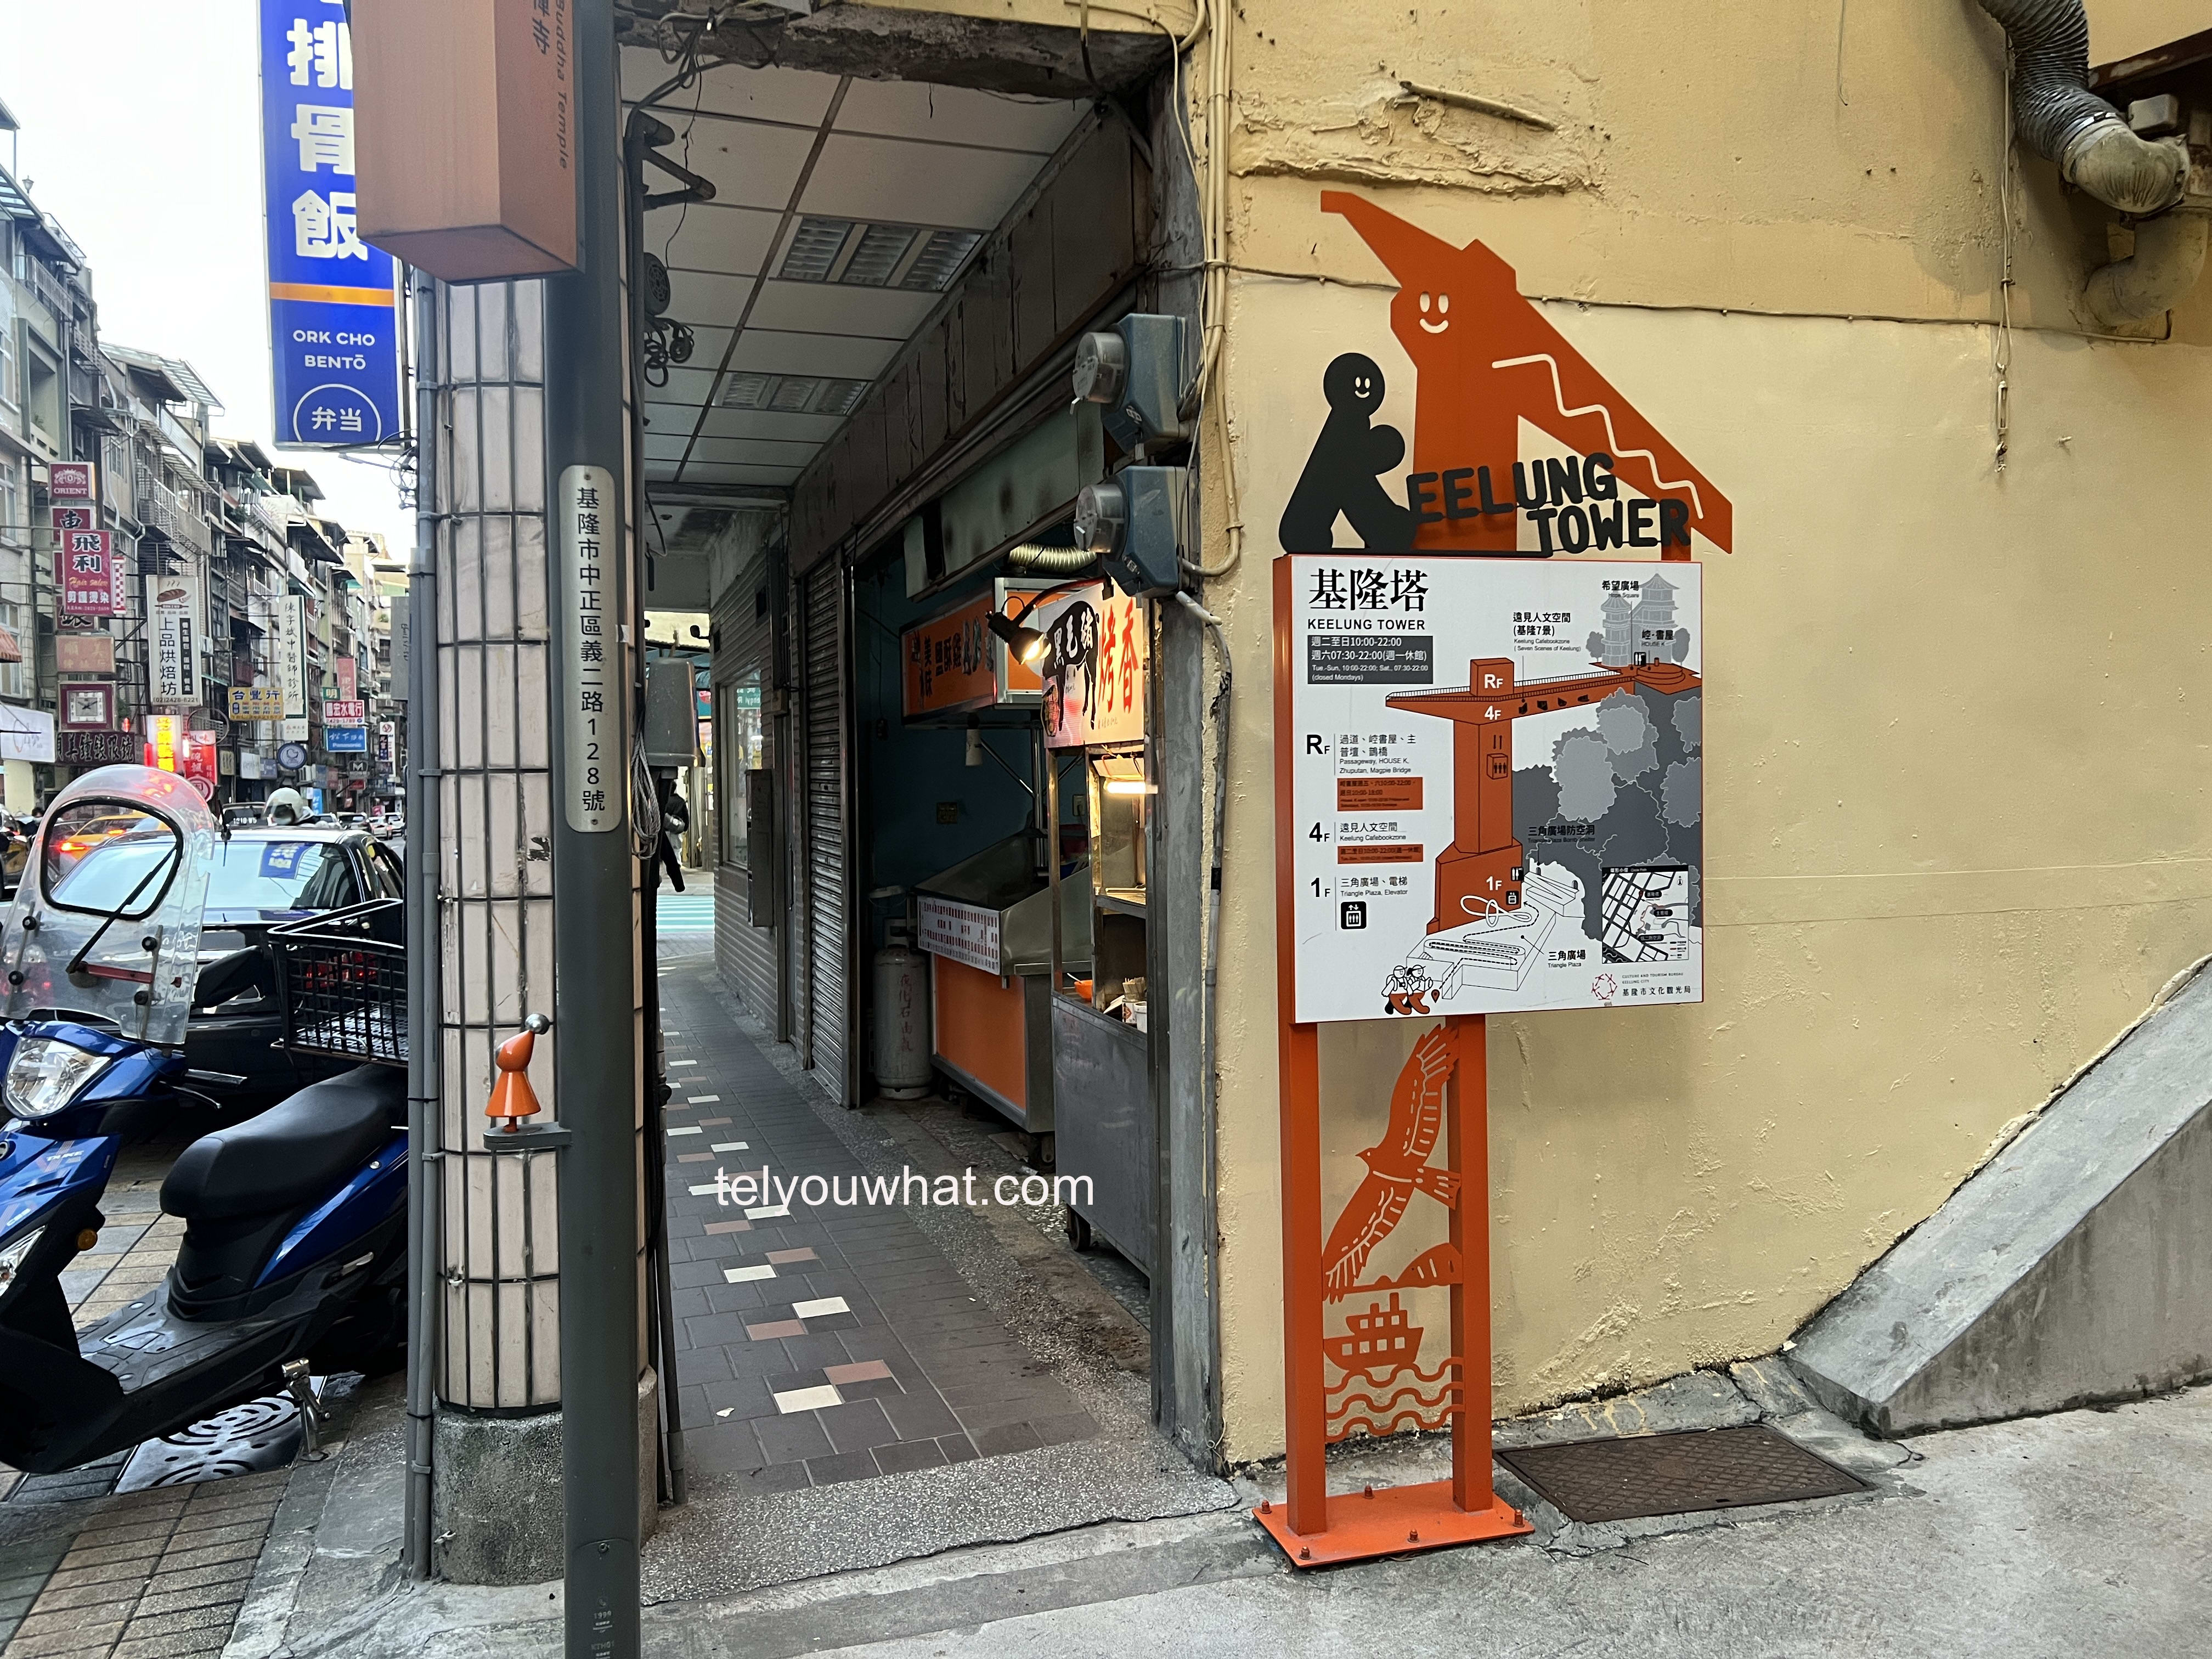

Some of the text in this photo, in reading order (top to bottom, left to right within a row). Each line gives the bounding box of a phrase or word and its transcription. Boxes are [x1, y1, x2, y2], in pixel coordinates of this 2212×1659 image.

[286, 0, 368, 261] 排骨飯
[557, 91, 569, 169] Temple
[293, 330, 375, 346] ORK CHO
[1527, 498, 1691, 557] TOWER
[72, 532, 102, 574] 飛利
[1308, 568, 1429, 612] 基隆塔
[1601, 580, 1640, 591] 希望廣場
[1308, 619, 1426, 630] KEELUNG TOWER
[1513, 612, 1571, 623] 遠見人文空間
[1513, 625, 1555, 637] (基隆7景)
[576, 487, 605, 811] 基隆市中正區義二路128號
[1311, 636, 1402, 647] 週二至日10:00-22:00
[159, 617, 177, 696] 上品烘焙坊
[1311, 650, 1426, 662] 週六07:30-22:00(週一休館)
[1484, 674, 1503, 689] RF
[326, 689, 338, 698] 明
[1484, 706, 1502, 720] 4F
[1306, 734, 1330, 755] RF
[1308, 822, 1330, 842] 4F
[1340, 822, 1398, 833] 遠見人文空間
[1528, 825, 1595, 836] 三角廣場防空洞
[1311, 877, 1331, 898] 1F
[1340, 876, 1408, 888] 三角廣場、電梯
[1486, 876, 1503, 891] 1F
[1548, 949, 1586, 961] 三角廣場
